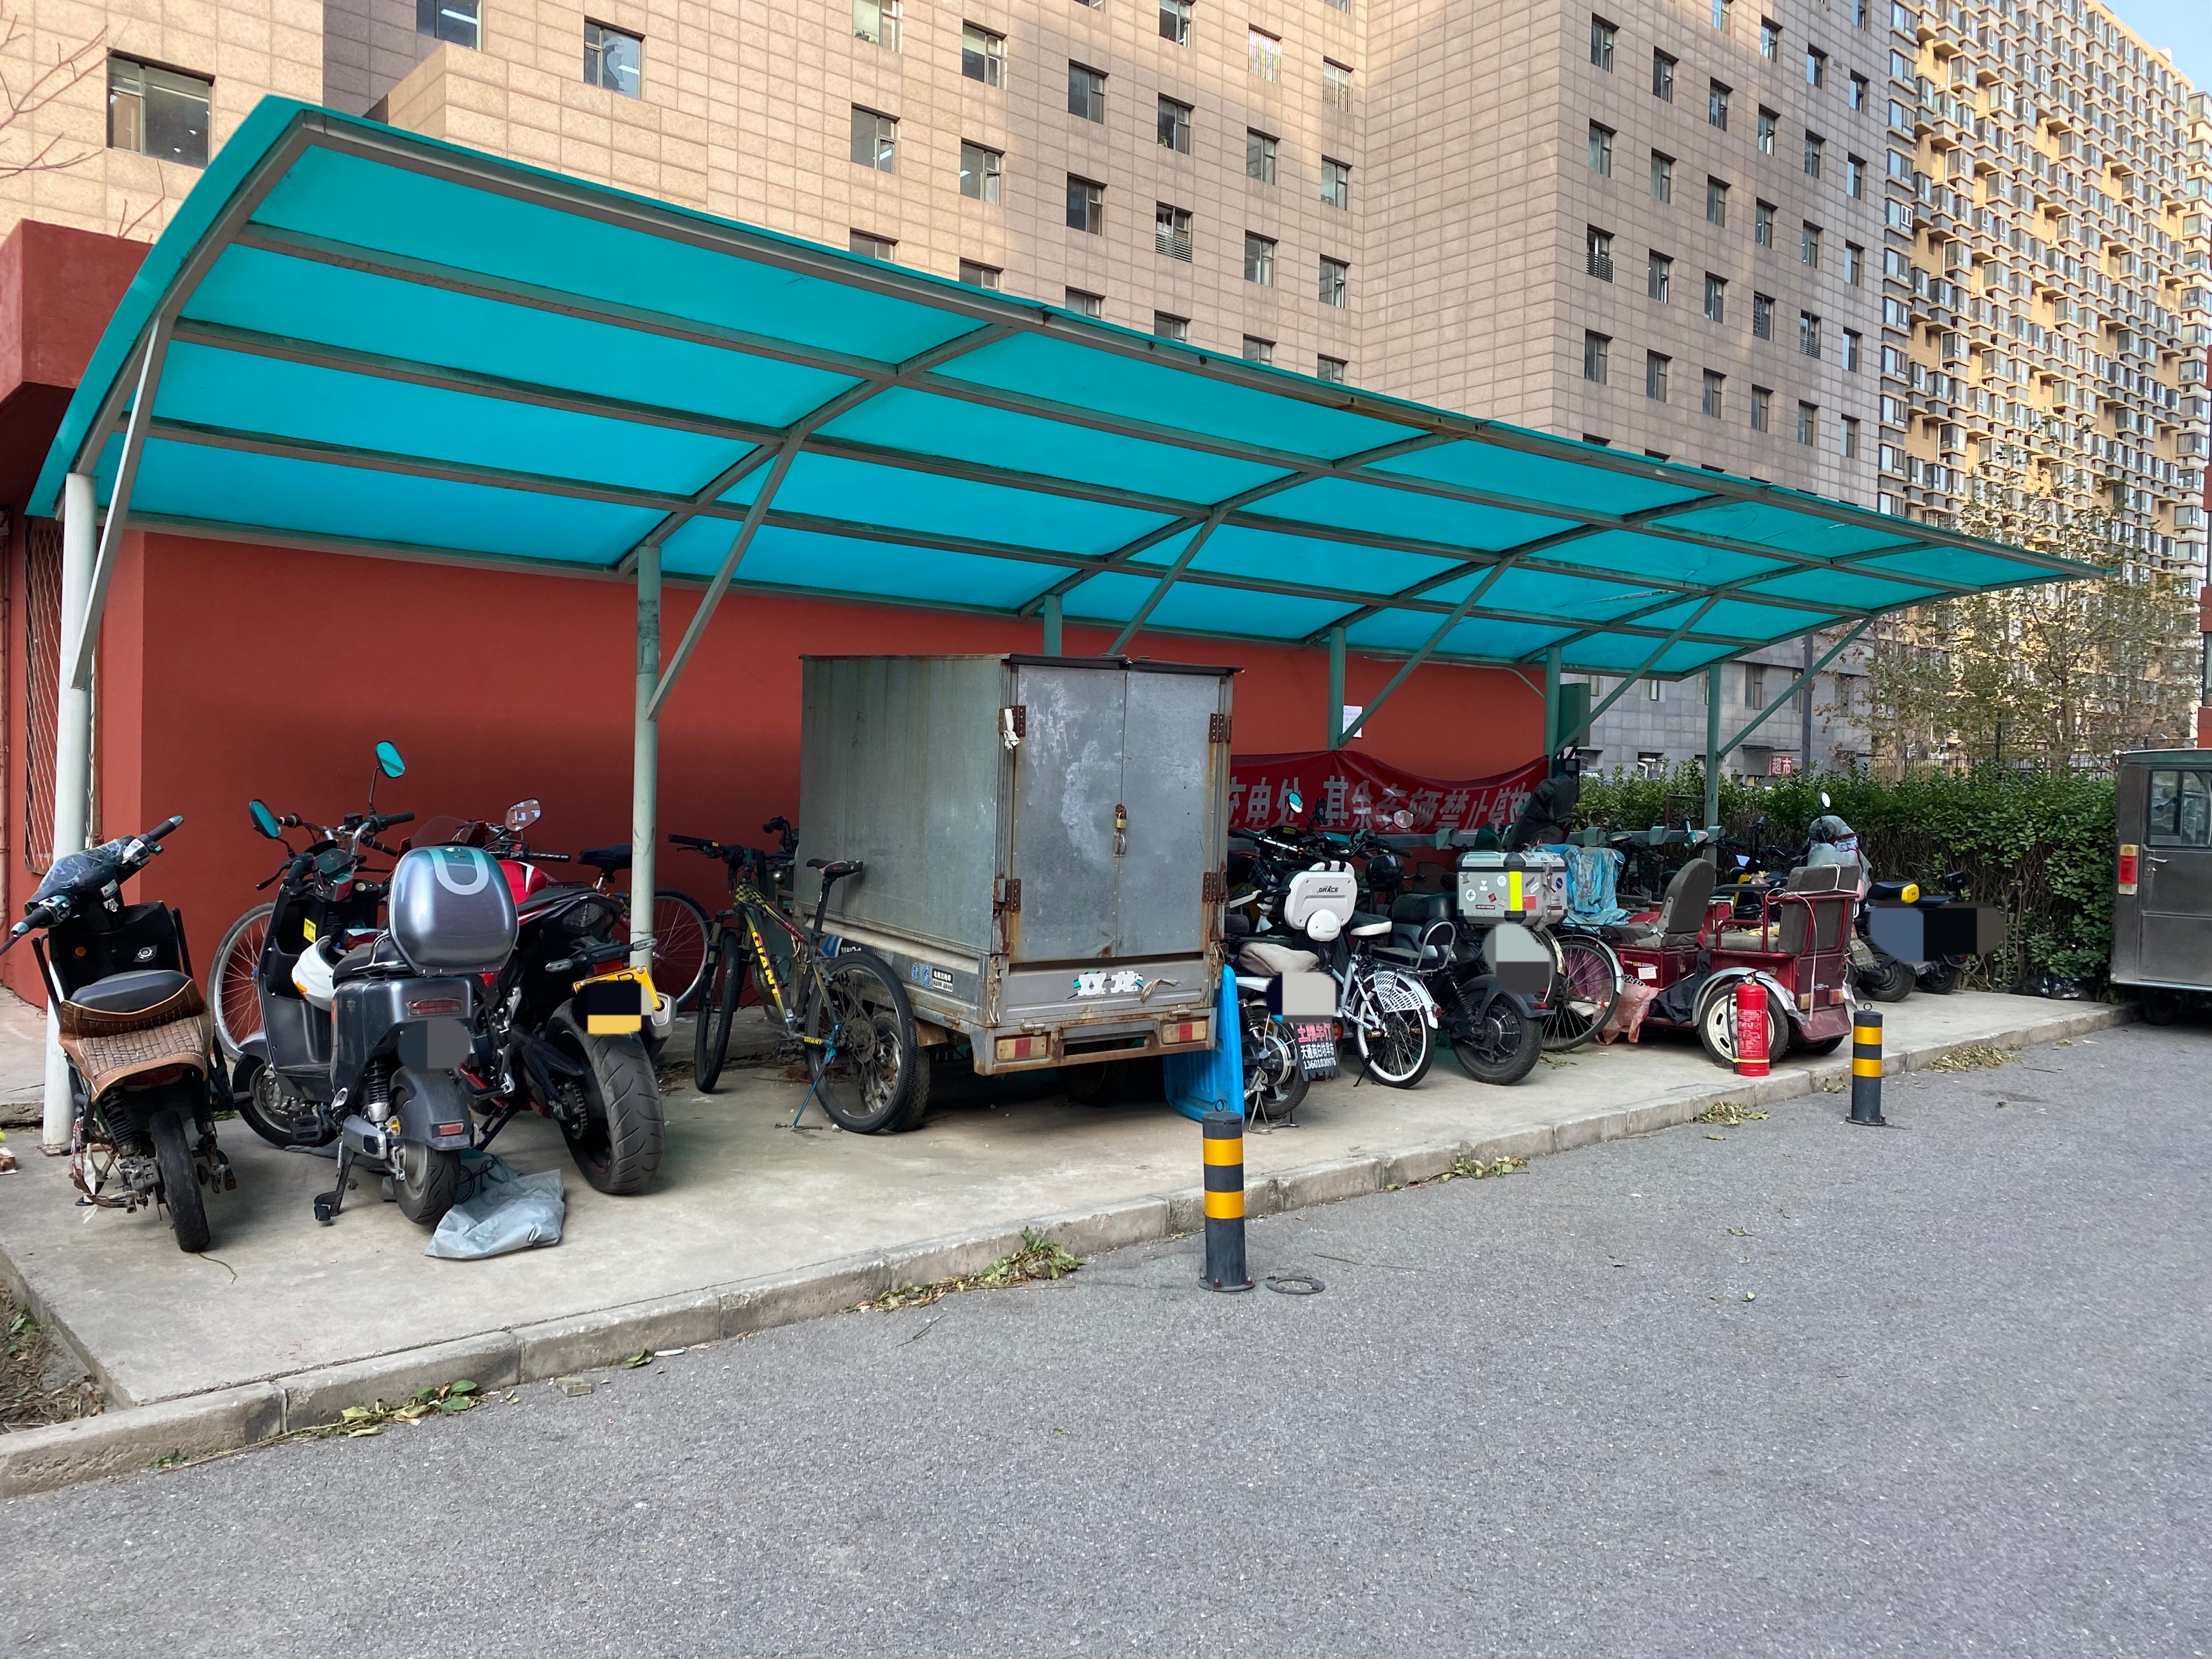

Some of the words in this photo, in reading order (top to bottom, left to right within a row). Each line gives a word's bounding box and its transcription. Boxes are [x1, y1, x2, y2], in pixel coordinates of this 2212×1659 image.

[1772, 756, 1791, 775] 超市
[1228, 776, 1303, 828] 充电处
[752, 931, 778, 995] GIANT
[1078, 971, 1138, 996] 双龙
[804, 1036, 823, 1045] GIANT
